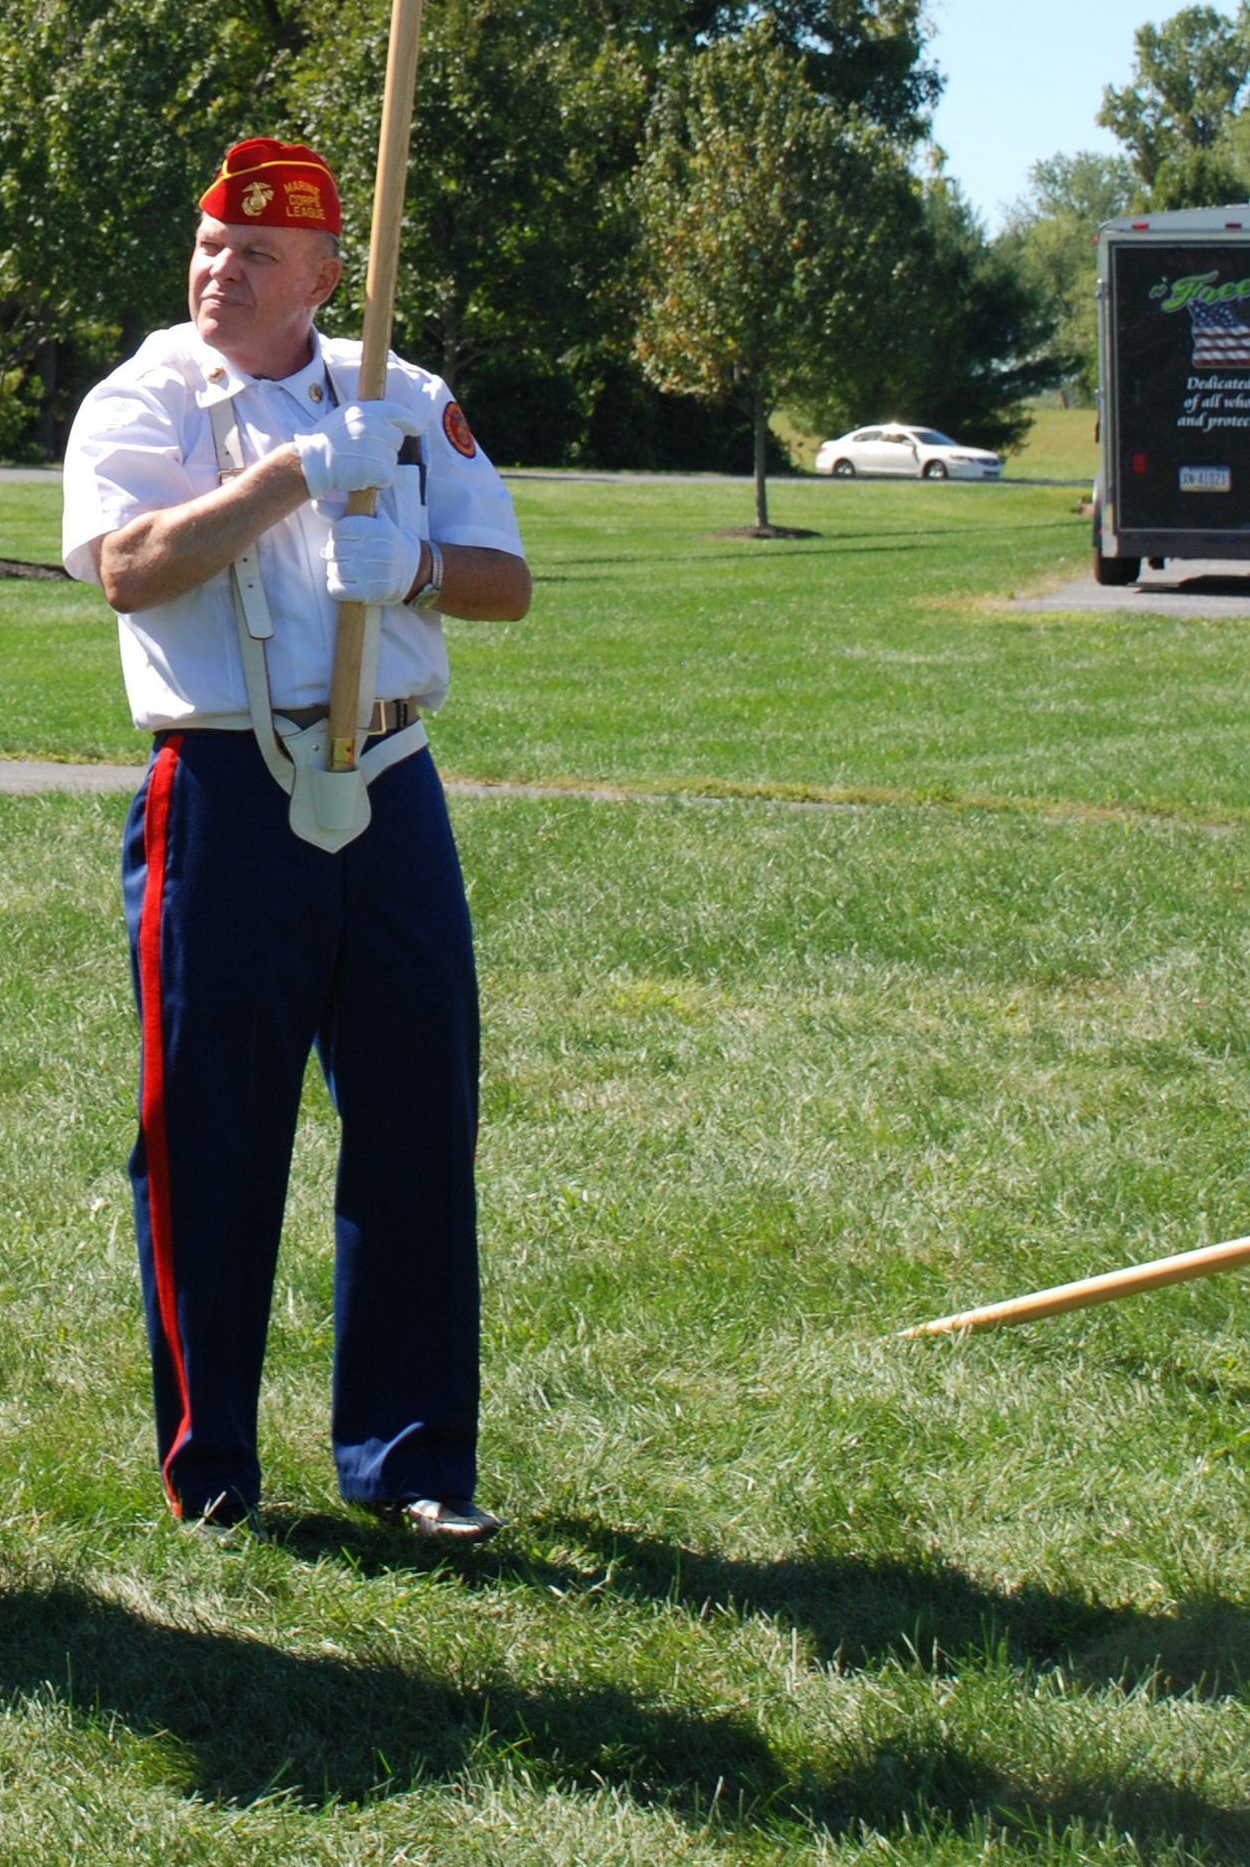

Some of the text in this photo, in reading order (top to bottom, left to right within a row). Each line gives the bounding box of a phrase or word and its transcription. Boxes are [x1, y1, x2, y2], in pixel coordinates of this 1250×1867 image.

[283, 180, 320, 199] MARINE
[289, 194, 320, 208] CORPS
[286, 206, 326, 220] LEAGUE
[1183, 392, 1250, 414] of all who
[1176, 411, 1207, 427] and
